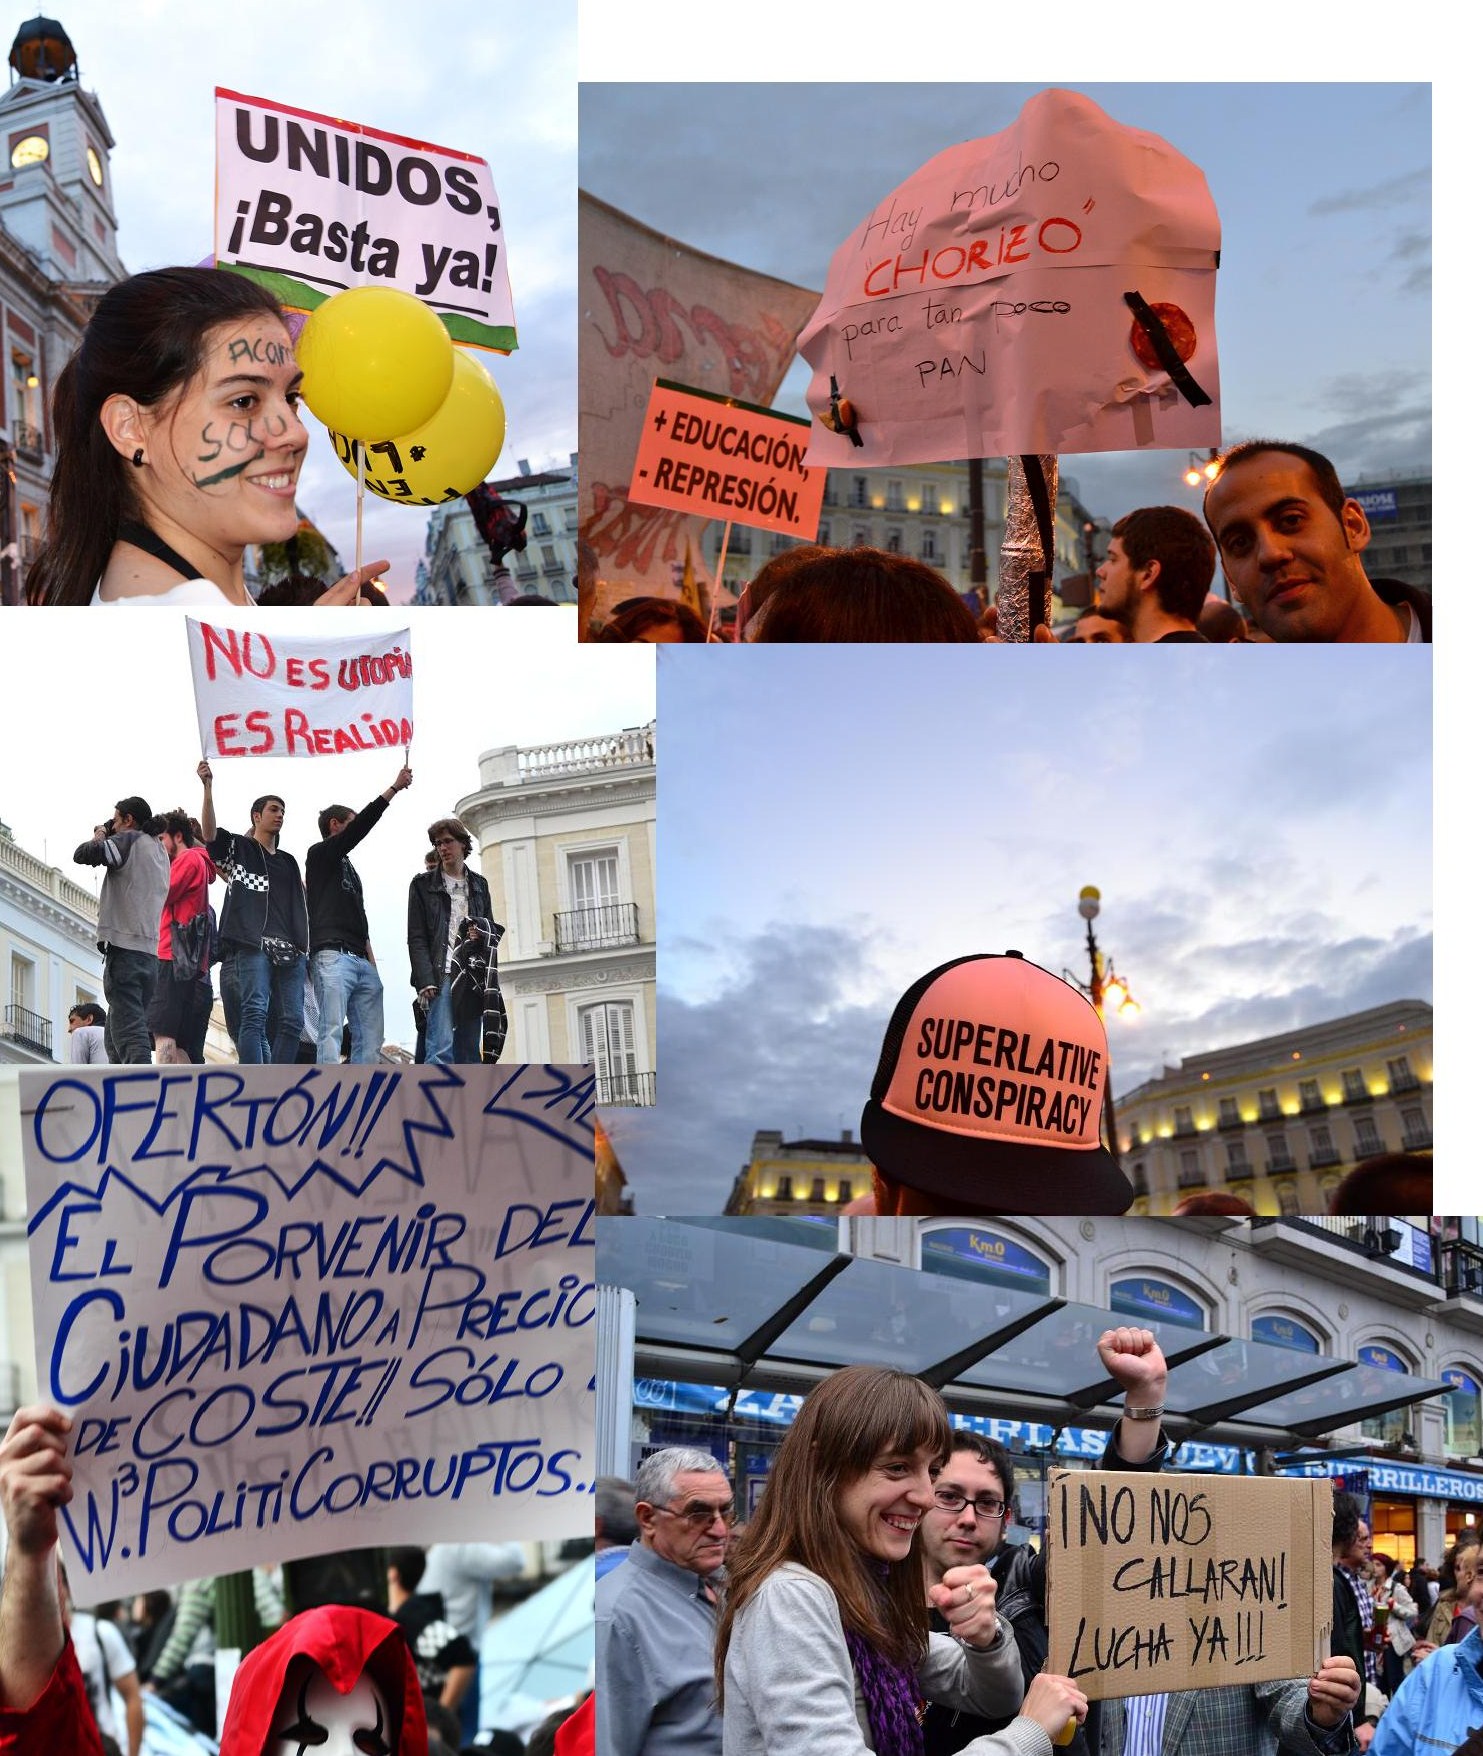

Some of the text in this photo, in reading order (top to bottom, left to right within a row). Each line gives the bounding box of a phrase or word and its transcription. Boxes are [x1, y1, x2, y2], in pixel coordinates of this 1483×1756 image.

[235, 108, 501, 231] UNIDOS,
[861, 150, 1060, 251] Hay mucho
[227, 189, 498, 295] ¡Basta ya!
[841, 300, 1071, 361] para tan poco
[914, 350, 988, 388] PAN
[670, 411, 809, 481] EDUCACIÓN,
[653, 457, 800, 524] REPRESIÓN.
[200, 621, 277, 681] NO
[286, 658, 331, 691] ES
[214, 710, 275, 756] ES
[917, 1017, 1101, 1091] SUPERLATIVE
[33, 1068, 402, 1165] OFERTÓN!!
[915, 1068, 1092, 1136] CONSPIRACY
[49, 1202, 133, 1283] EL
[494, 1198, 595, 1262] DEL
[74, 1346, 565, 1460] DE COSTE!! SÓLO
[1150, 1489, 1212, 1546] NOS
[1113, 1552, 1287, 1610] CALLARAN!
[1067, 1611, 1266, 1679] LUCHA YA!!!
